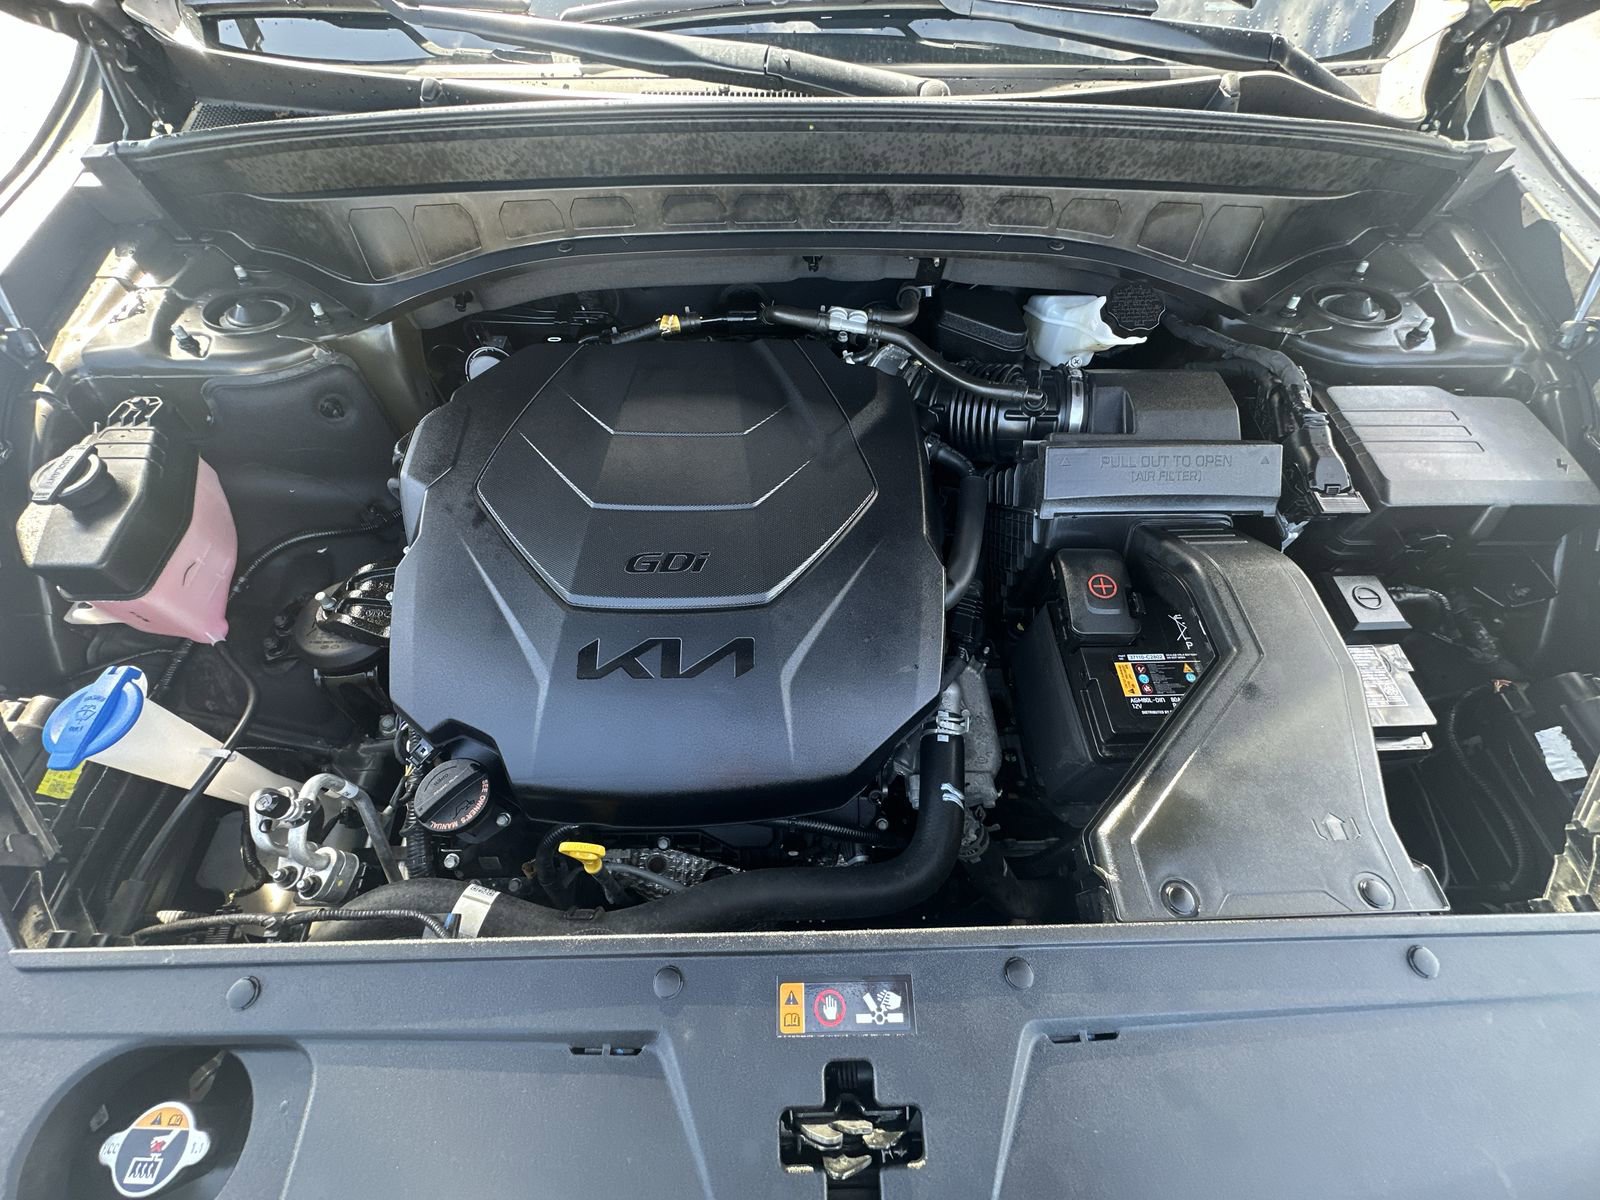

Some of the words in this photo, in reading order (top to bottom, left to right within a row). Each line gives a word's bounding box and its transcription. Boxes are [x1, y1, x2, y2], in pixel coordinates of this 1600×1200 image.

[1101, 456, 1136, 468] PULL
[1141, 455, 1168, 468] OUT
[1173, 455, 1192, 467] TO
[1195, 455, 1233, 467] OPEN
[623, 552, 712, 575] GDi
[576, 636, 756, 680] KIA
[481, 779, 489, 793] SEE
[460, 794, 487, 824] OWNER'S
[430, 820, 459, 830] MANUAL
